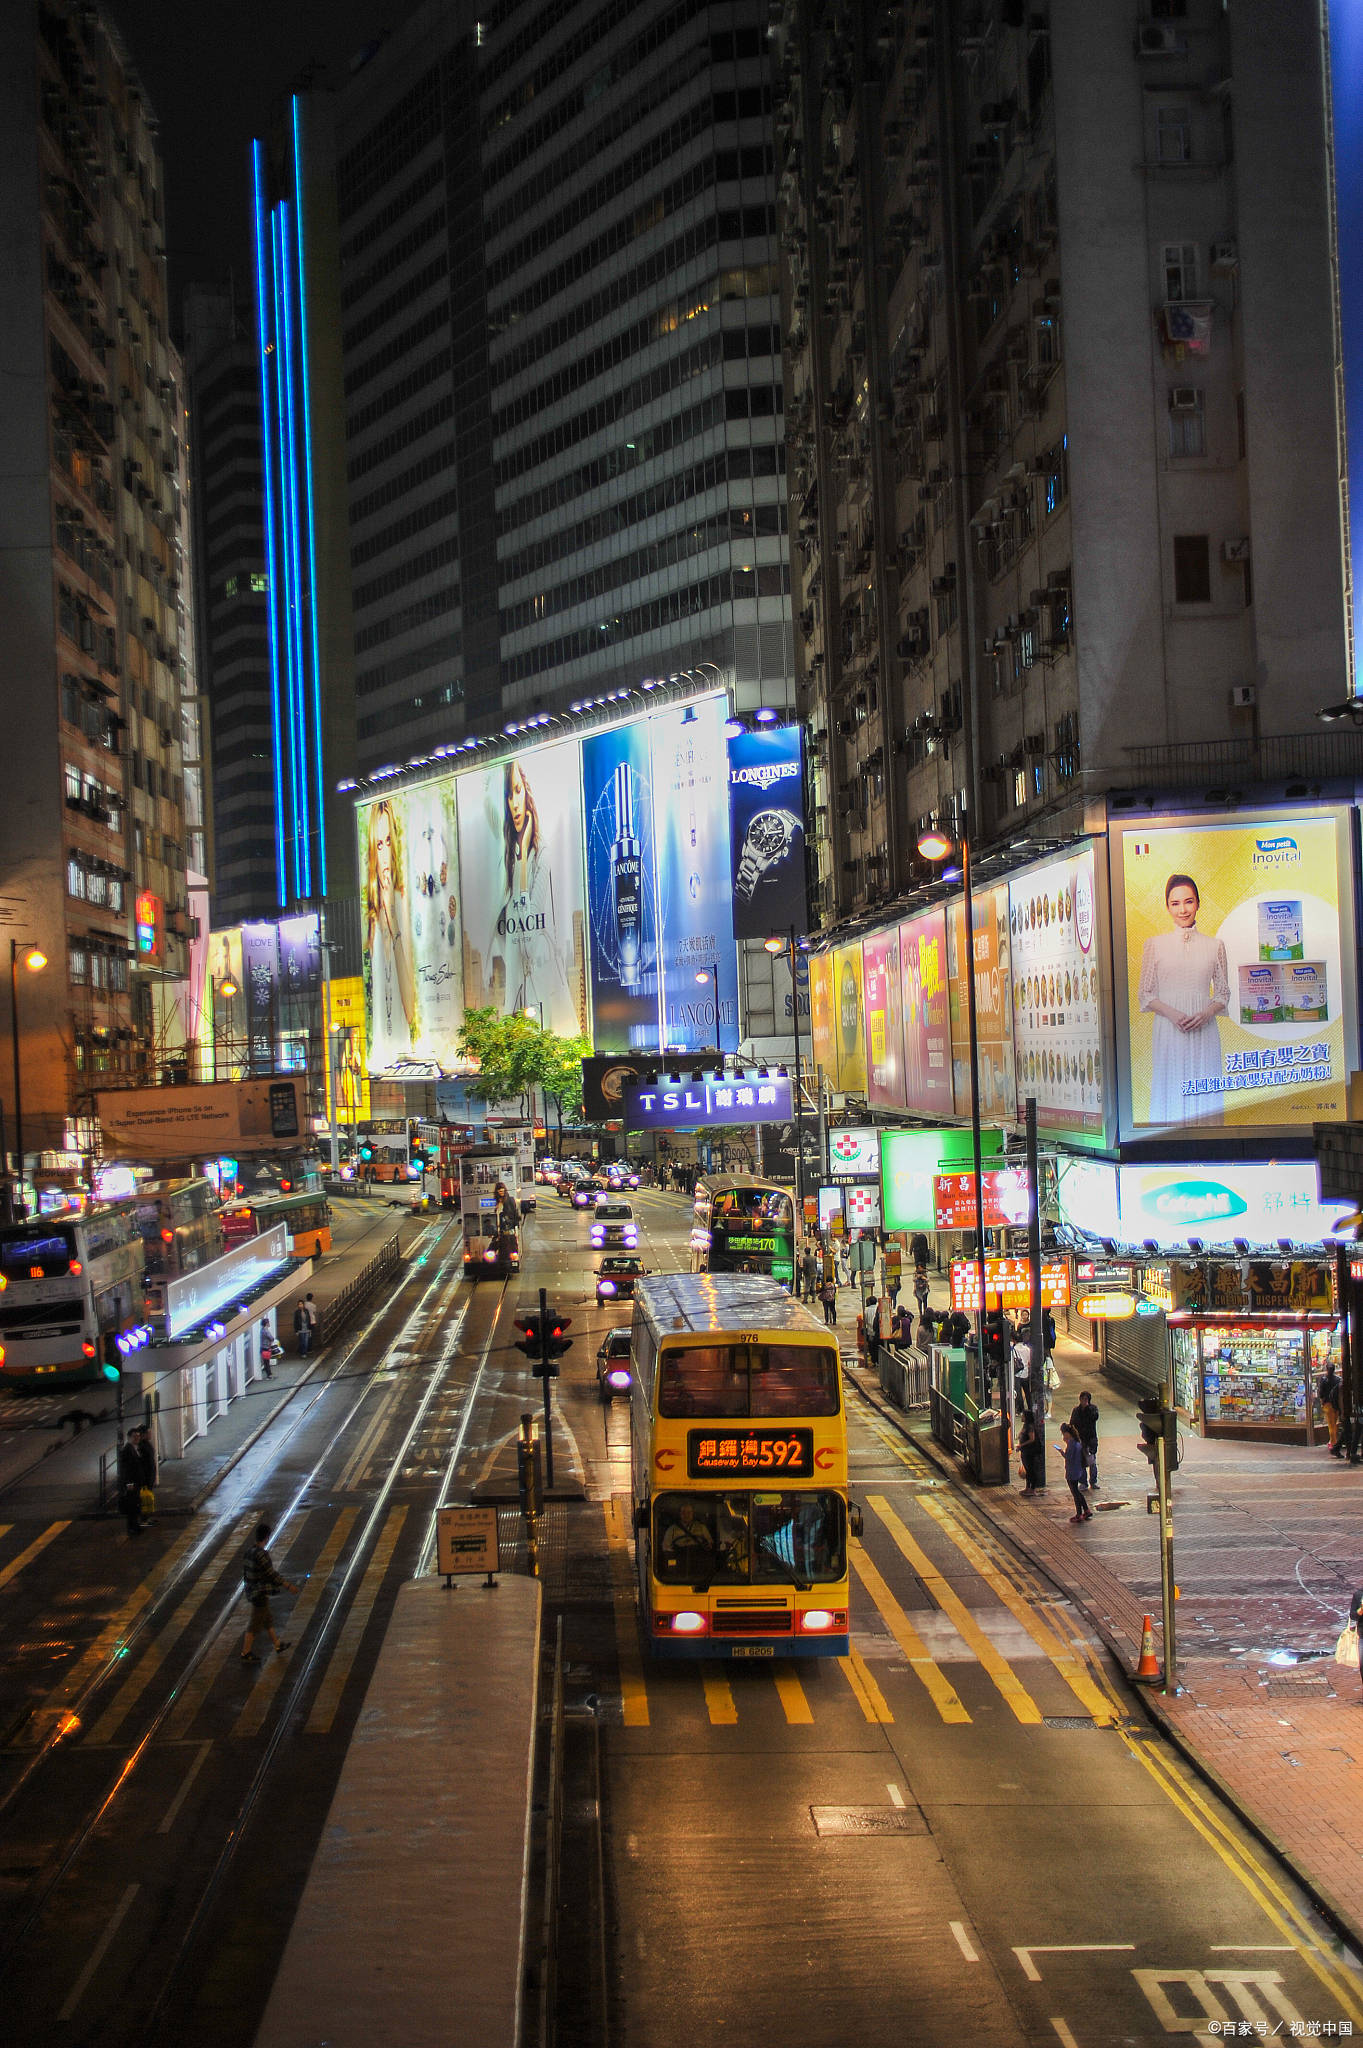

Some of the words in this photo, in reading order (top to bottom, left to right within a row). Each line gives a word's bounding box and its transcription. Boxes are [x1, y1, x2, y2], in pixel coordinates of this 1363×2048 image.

[731, 762, 798, 783] LONGINES
[1253, 850, 1301, 863] Inovital
[497, 912, 545, 935] COACH
[1294, 930, 1300, 942] 1
[250, 938, 272, 948] LOVE
[1274, 994, 1280, 1006] 2
[1226, 1043, 1330, 1072] 法國育嬰之寶
[639, 1092, 701, 1110] TSL
[126, 1109, 166, 1118] Experience
[167, 1107, 192, 1116] iPhone
[137, 1116, 173, 1126] Dual-Band
[201, 1112, 230, 1120] Network
[938, 1172, 1028, 1192] 新昌大房
[760, 1239, 776, 1250] 170
[30, 1266, 45, 1278] 116
[1215, 1294, 1249, 1305] CHEUNG
[1257, 1294, 1313, 1306] DISPENSARY
[740, 1334, 759, 1342] 976
[699, 1440, 758, 1458] 銅鑼灣
[759, 1440, 803, 1466] 592
[697, 1456, 740, 1467] Causeway
[742, 1457, 759, 1468] Bay
